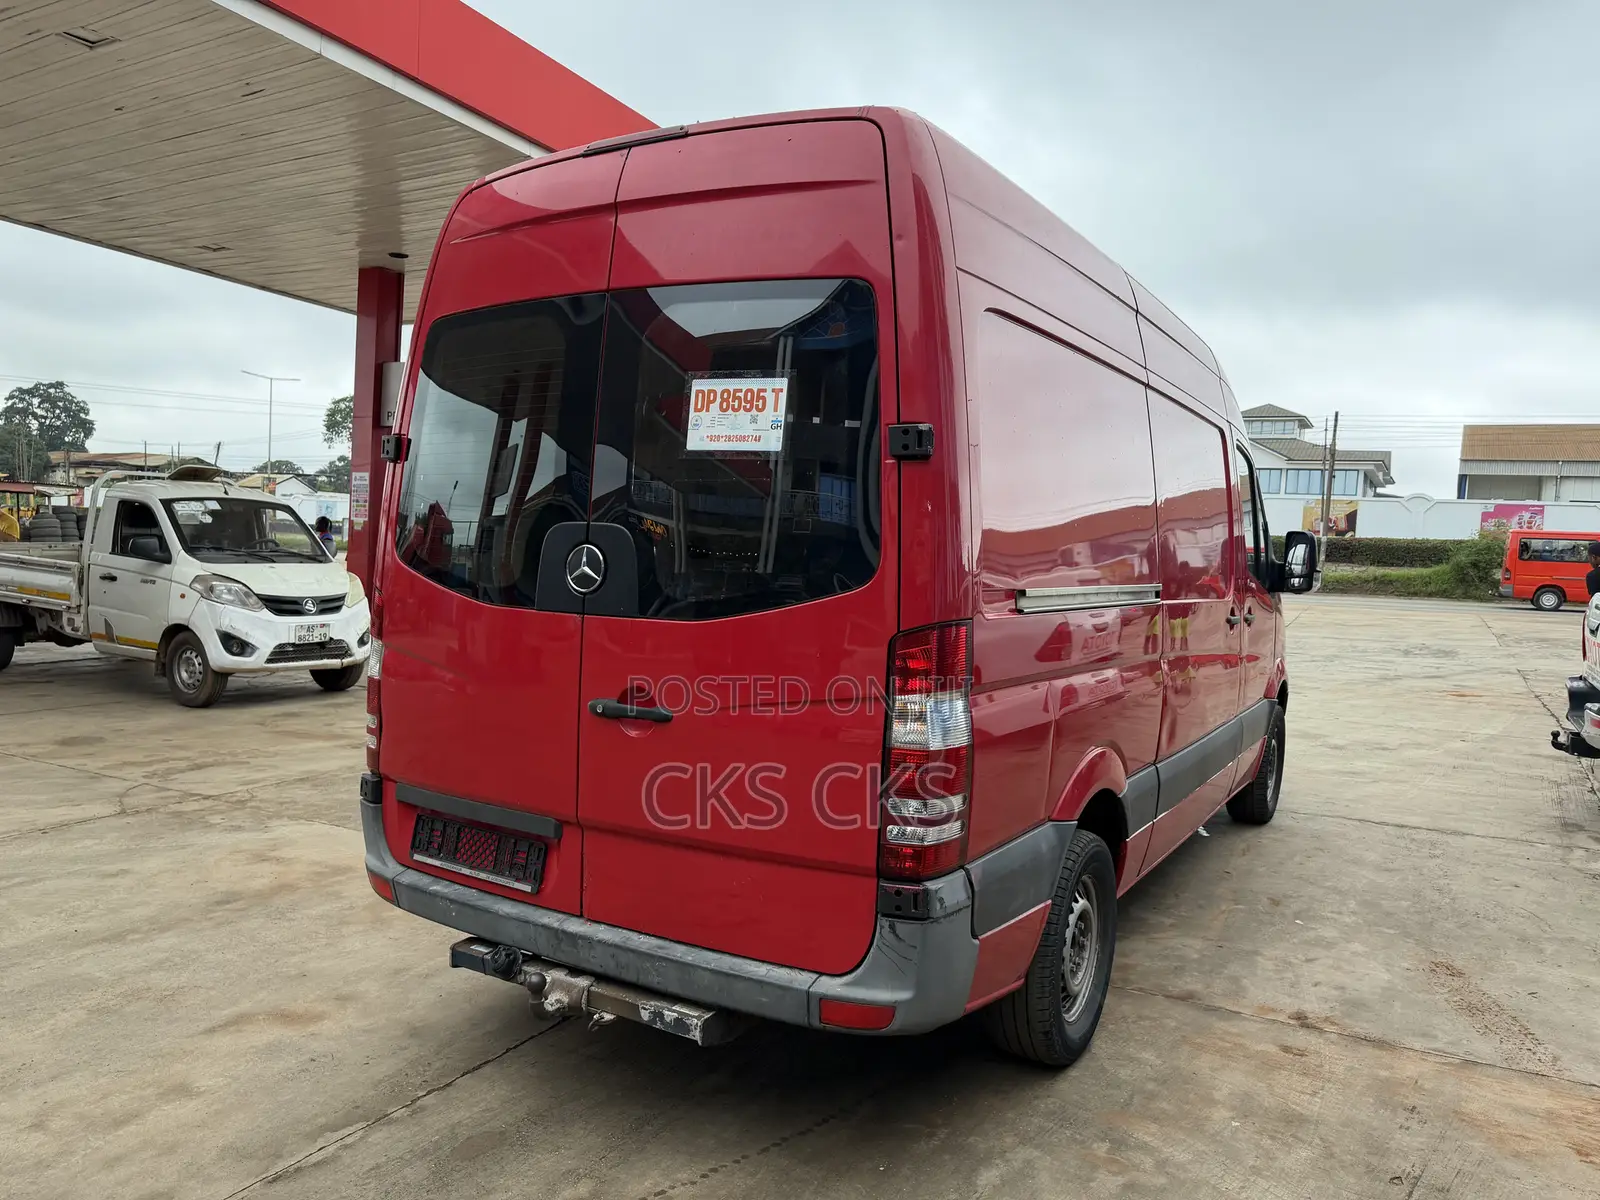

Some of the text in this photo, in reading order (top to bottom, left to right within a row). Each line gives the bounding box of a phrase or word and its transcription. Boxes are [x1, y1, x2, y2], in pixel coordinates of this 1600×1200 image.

[693, 388, 784, 413] DP 8595 T
[297, 632, 328, 642] 8821-19
